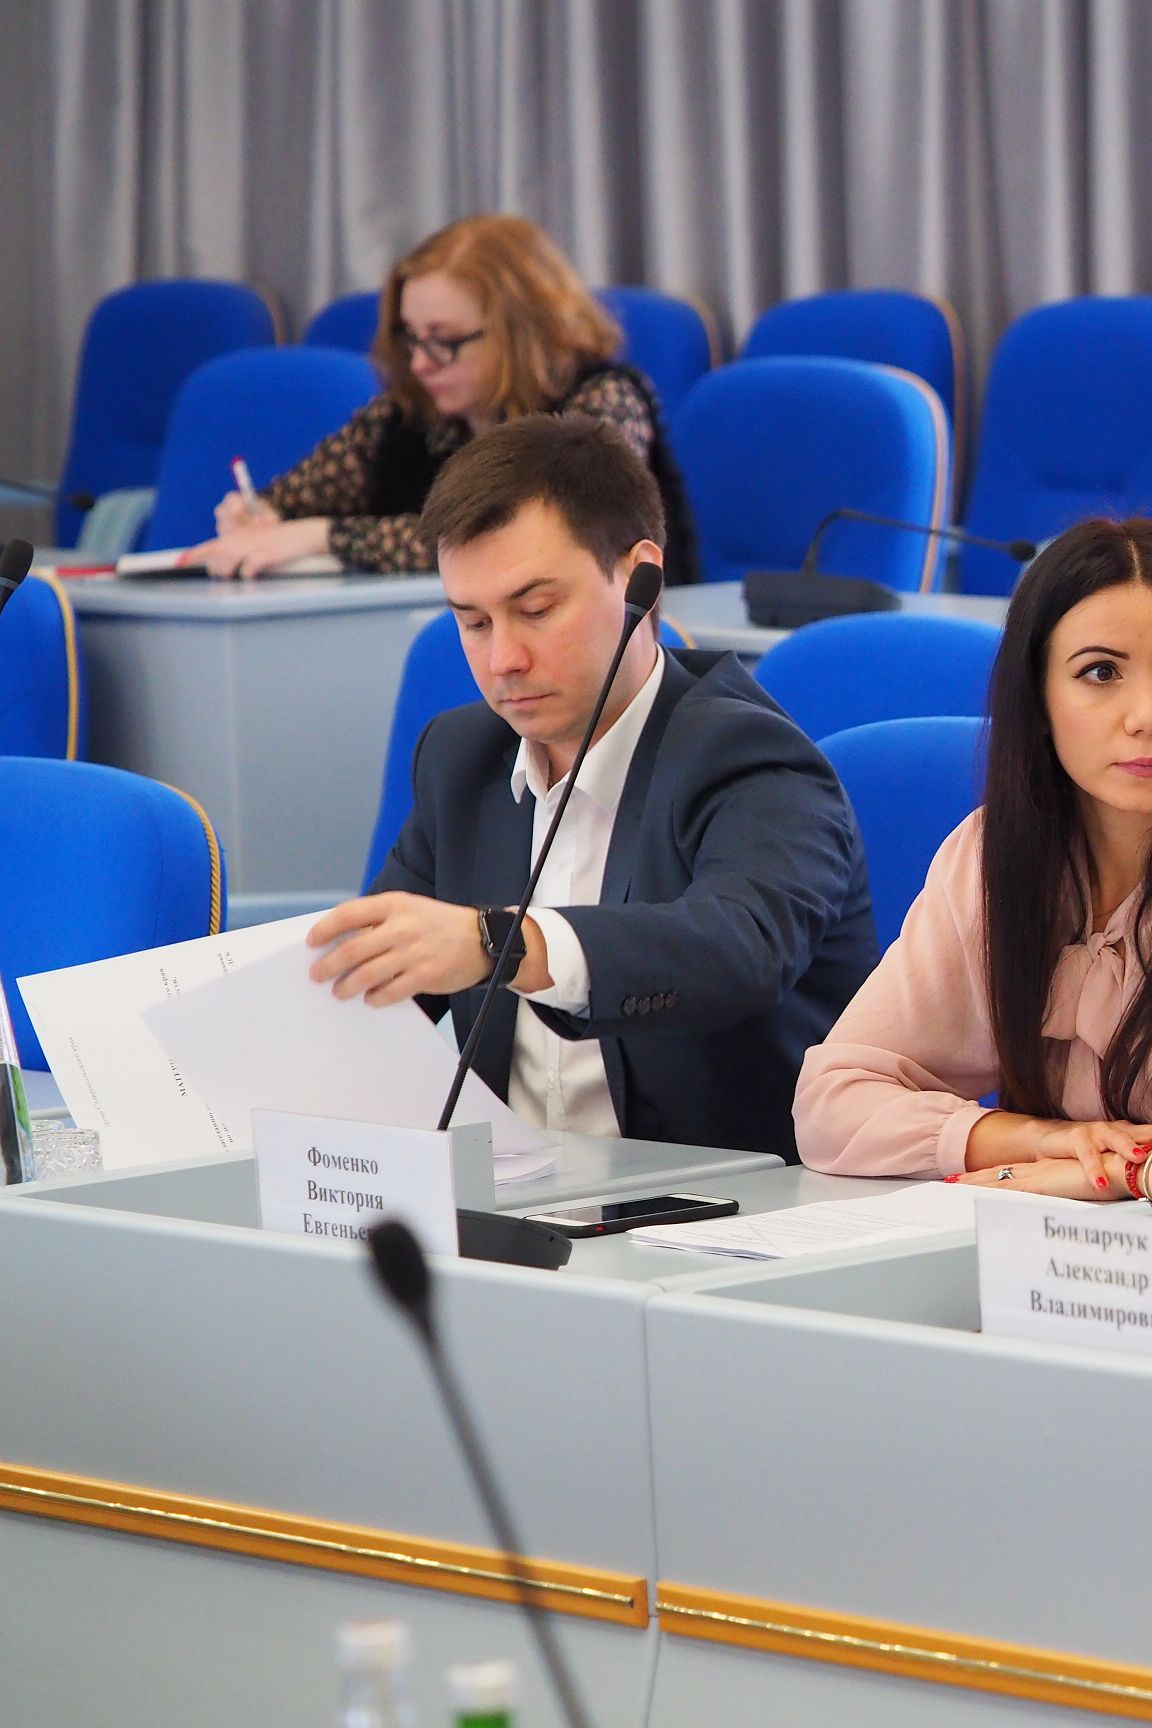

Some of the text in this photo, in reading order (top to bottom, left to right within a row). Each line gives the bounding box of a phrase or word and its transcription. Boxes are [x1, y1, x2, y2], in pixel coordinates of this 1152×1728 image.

[306, 1146, 379, 1176] Фоменко
[306, 1180, 384, 1212] Виктория
[303, 1213, 372, 1241] Евгенье
[1043, 1216, 1149, 1254] Бондарчук
[1045, 1256, 1149, 1295] Александр
